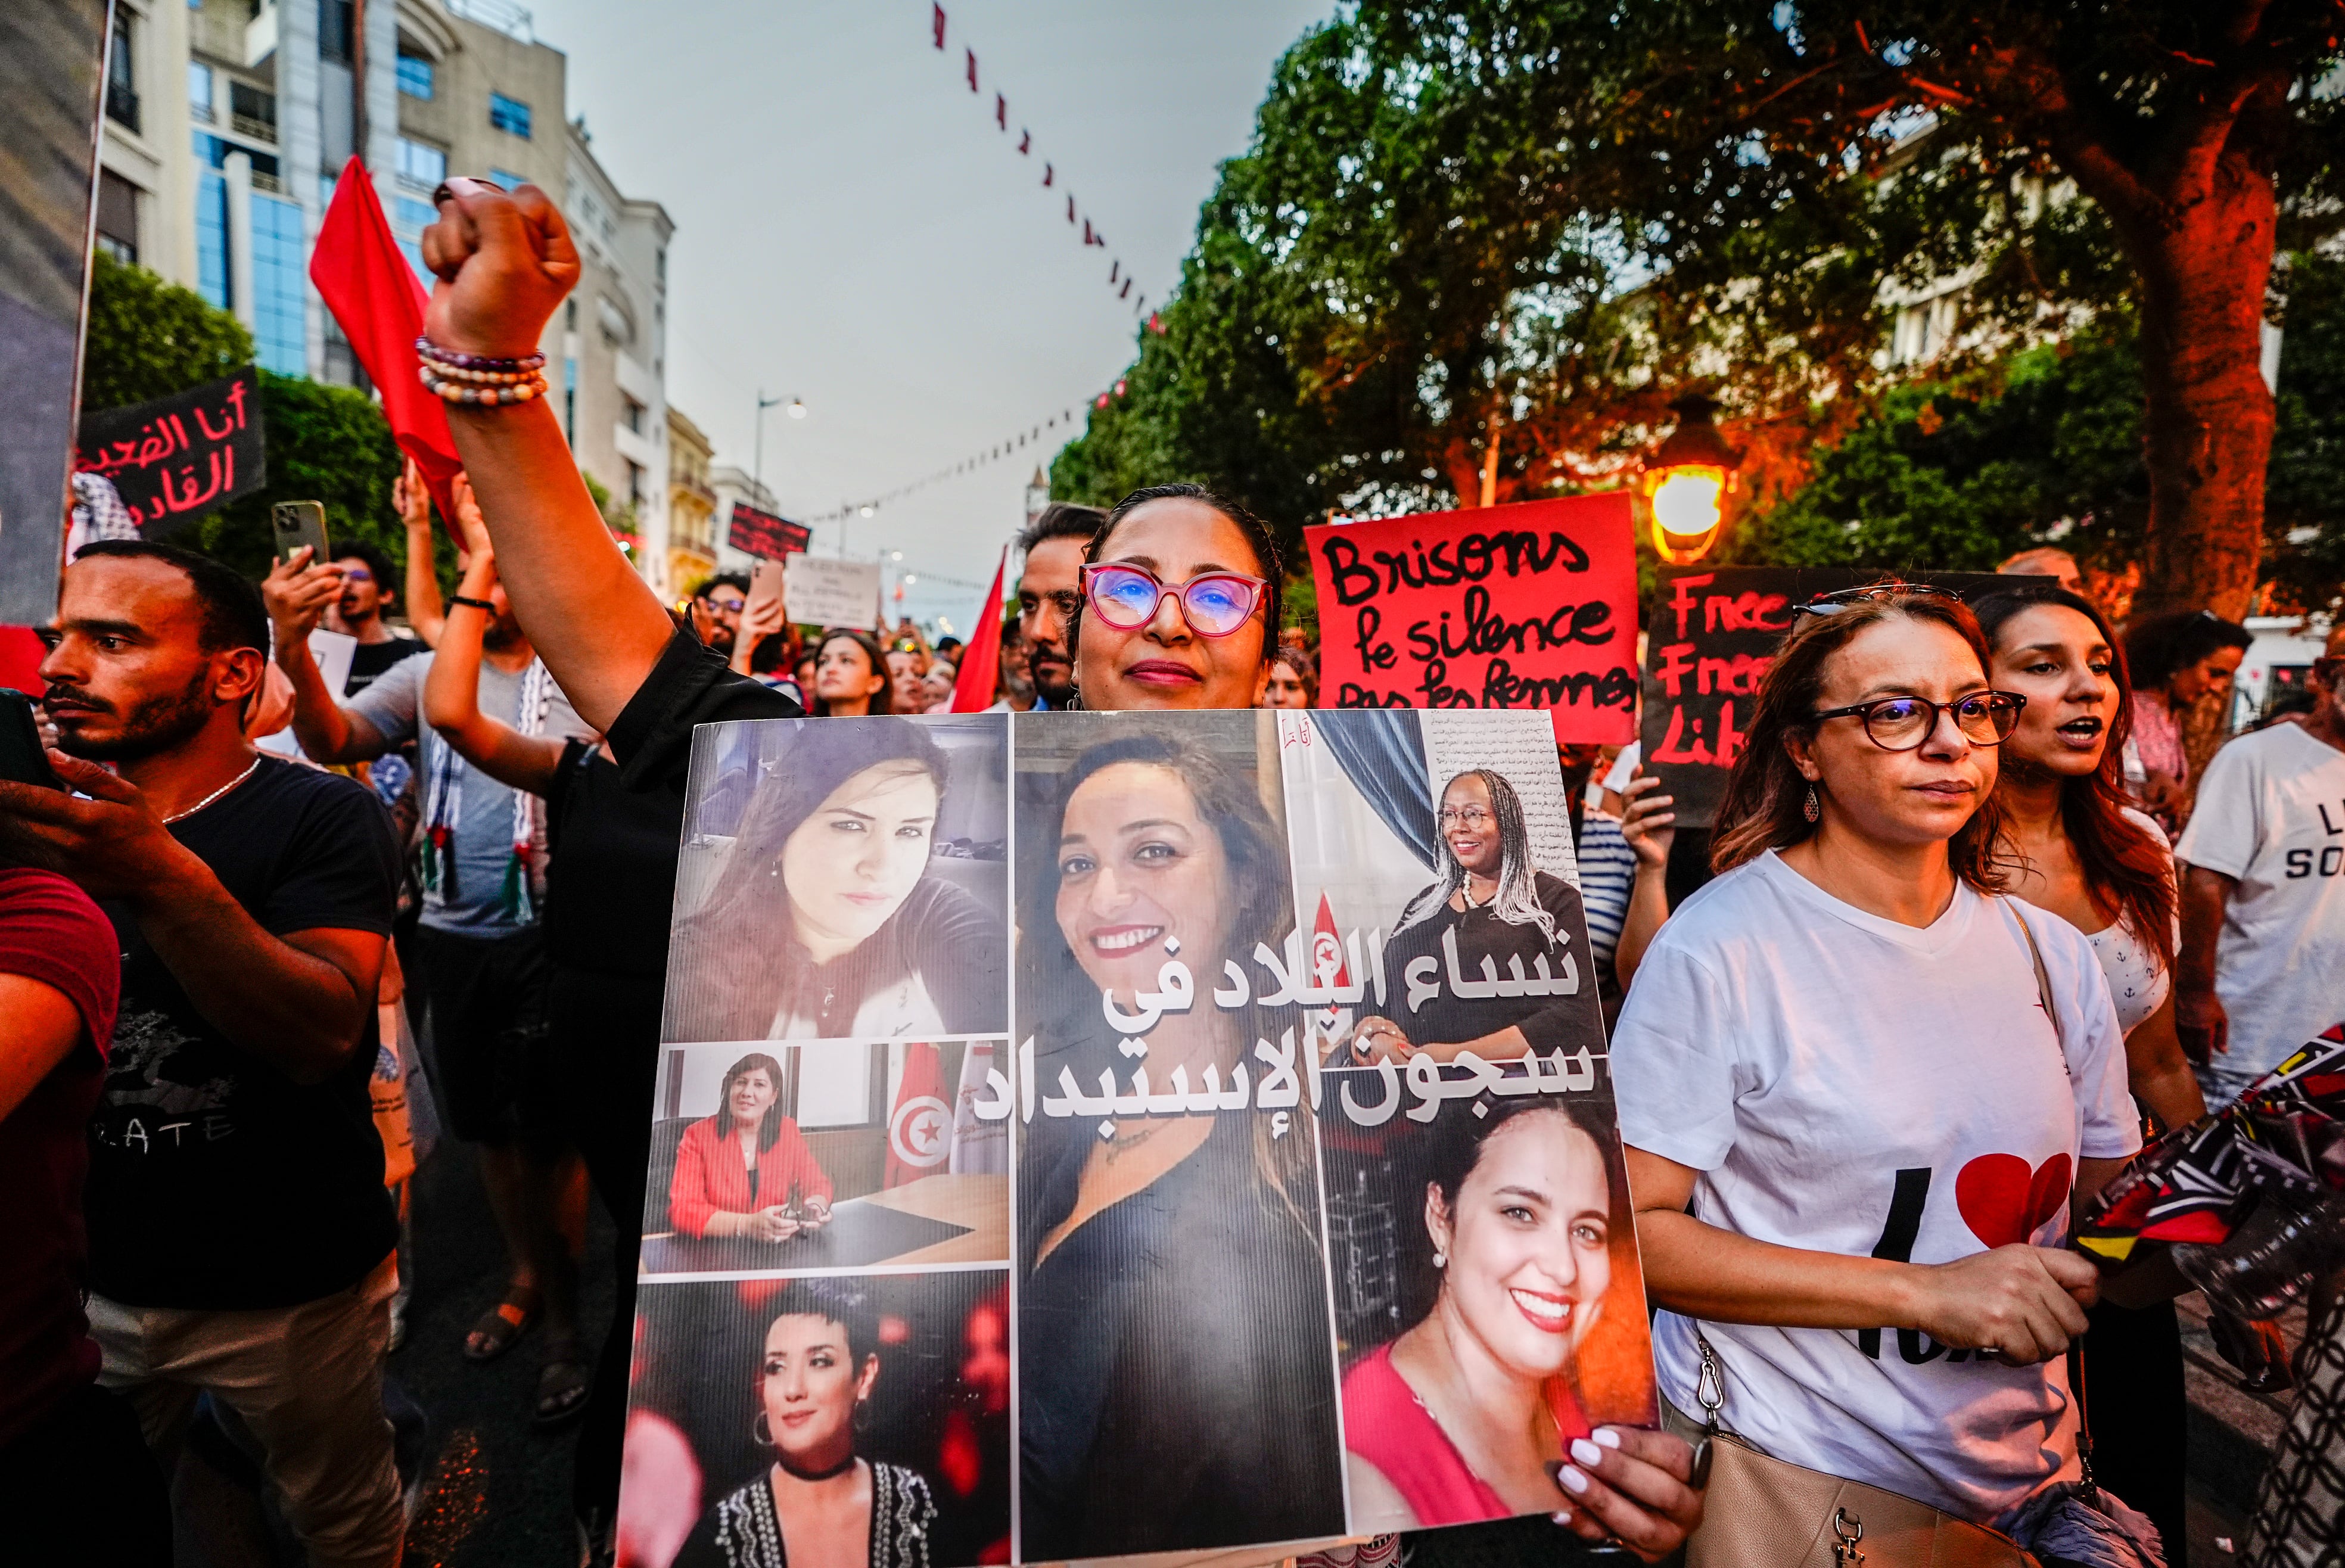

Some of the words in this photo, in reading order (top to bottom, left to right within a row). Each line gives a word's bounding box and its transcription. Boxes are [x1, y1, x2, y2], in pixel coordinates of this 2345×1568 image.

[194, 380, 247, 441] أنا
[1321, 530, 1590, 606] Brisons
[1668, 573, 1792, 640] Free
[1354, 605, 1398, 674] le
[1407, 584, 1616, 662] silence
[1650, 699, 1749, 770] Lib
[2317, 798, 2345, 836] L
[2285, 846, 2345, 879] SO
[1103, 931, 1195, 1034] في
[1214, 926, 1387, 1025] البلاد
[1407, 925, 1579, 1013] نساء
[974, 1023, 1323, 1140] الإستبداد
[1340, 1035, 1594, 1127] سجون
